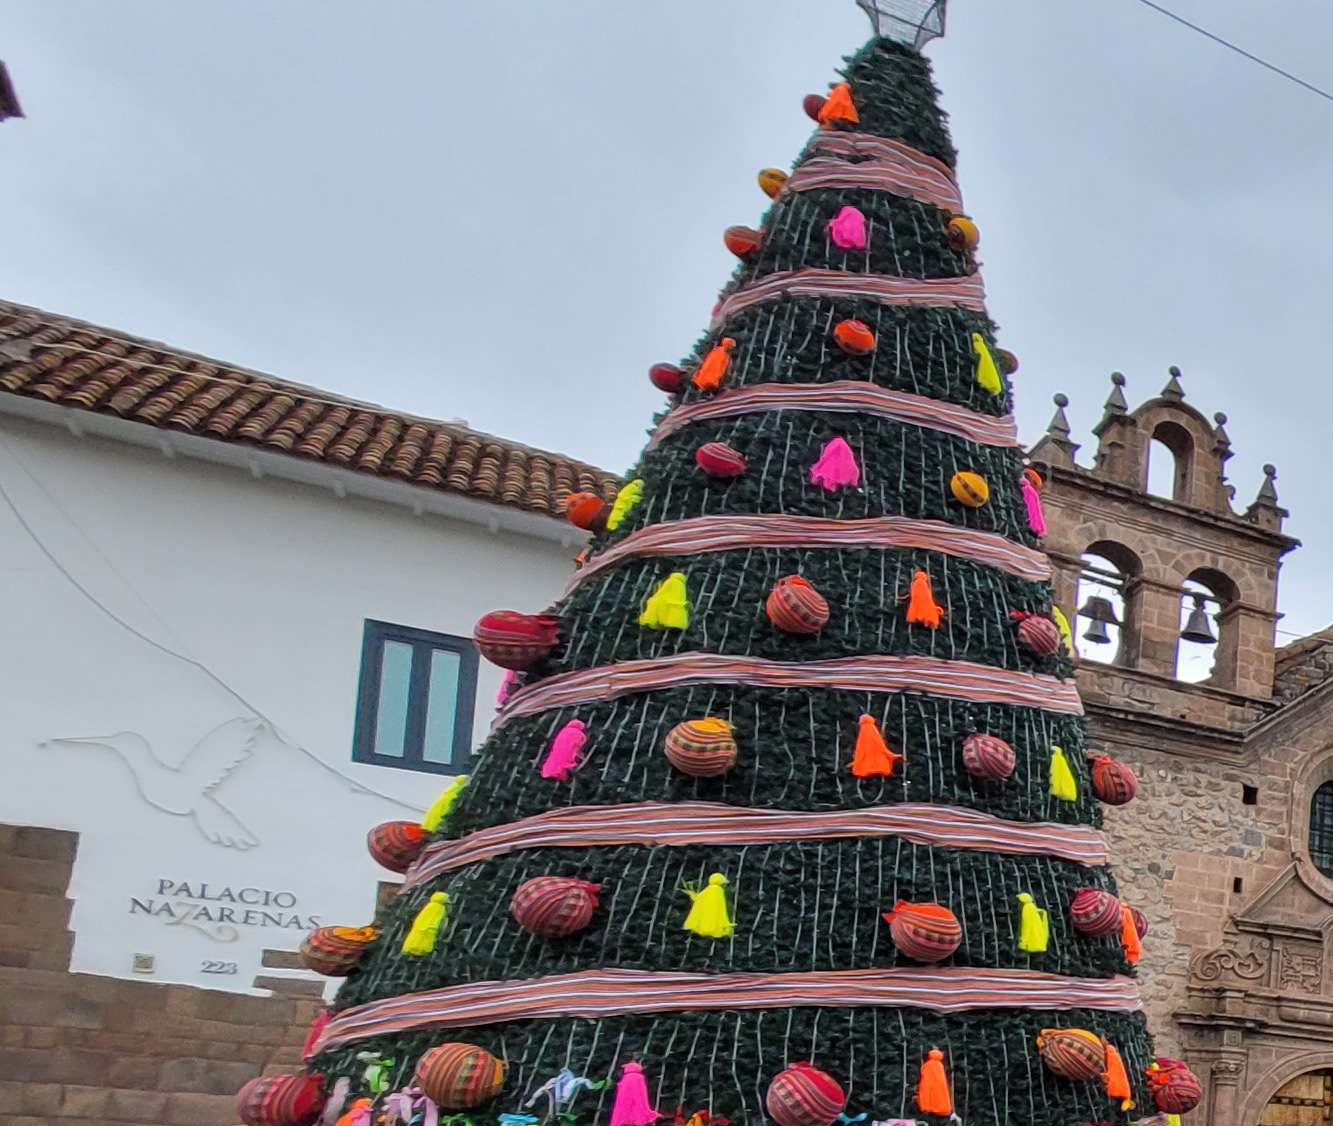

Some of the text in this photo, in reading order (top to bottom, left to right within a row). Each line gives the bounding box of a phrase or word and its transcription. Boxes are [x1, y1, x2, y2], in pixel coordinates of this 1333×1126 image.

[157, 878, 297, 909] PALACIO
[129, 896, 322, 944] NAZARENAS
[200, 959, 238, 975] 223
